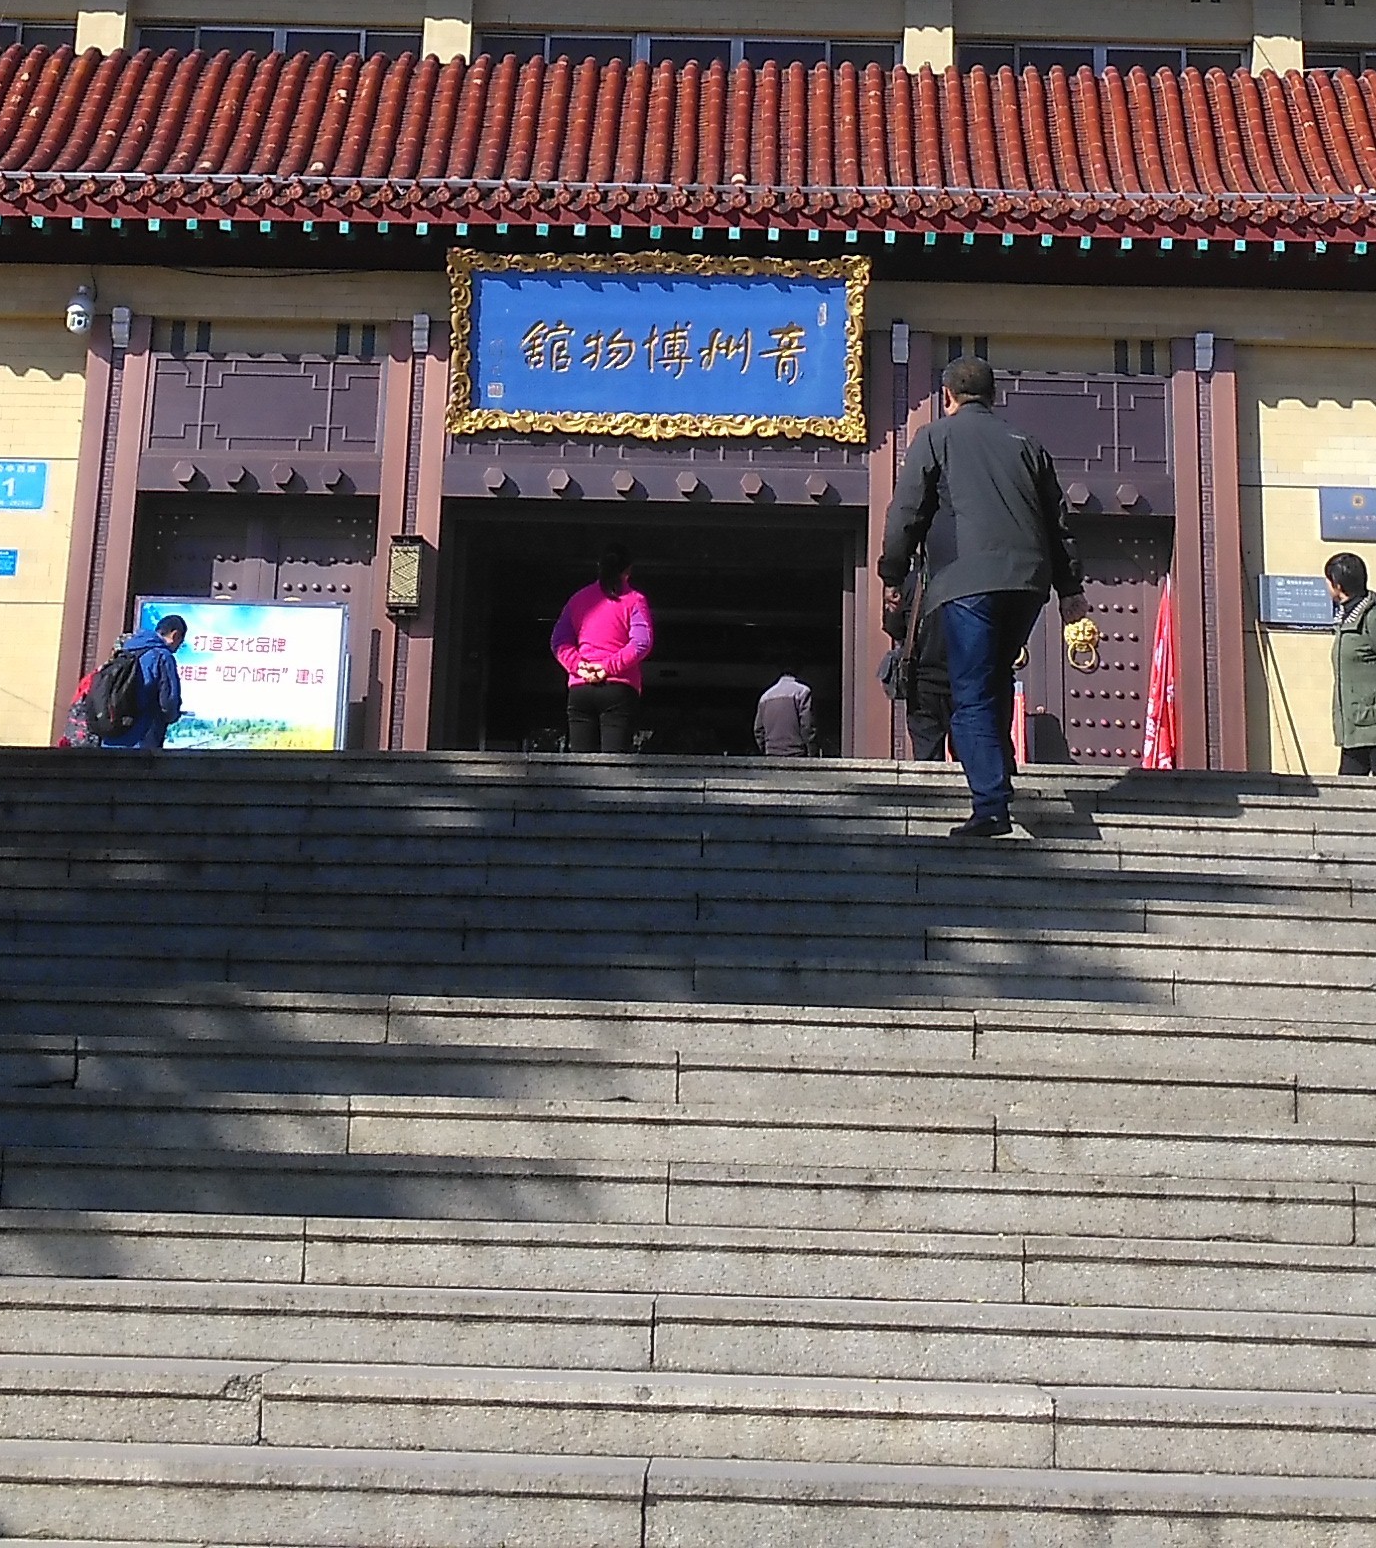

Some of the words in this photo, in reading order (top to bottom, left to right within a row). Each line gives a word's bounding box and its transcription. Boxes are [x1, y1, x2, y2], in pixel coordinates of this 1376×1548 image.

[2, 477, 15, 497] 1
[194, 635, 286, 653] 打造文化品牌
